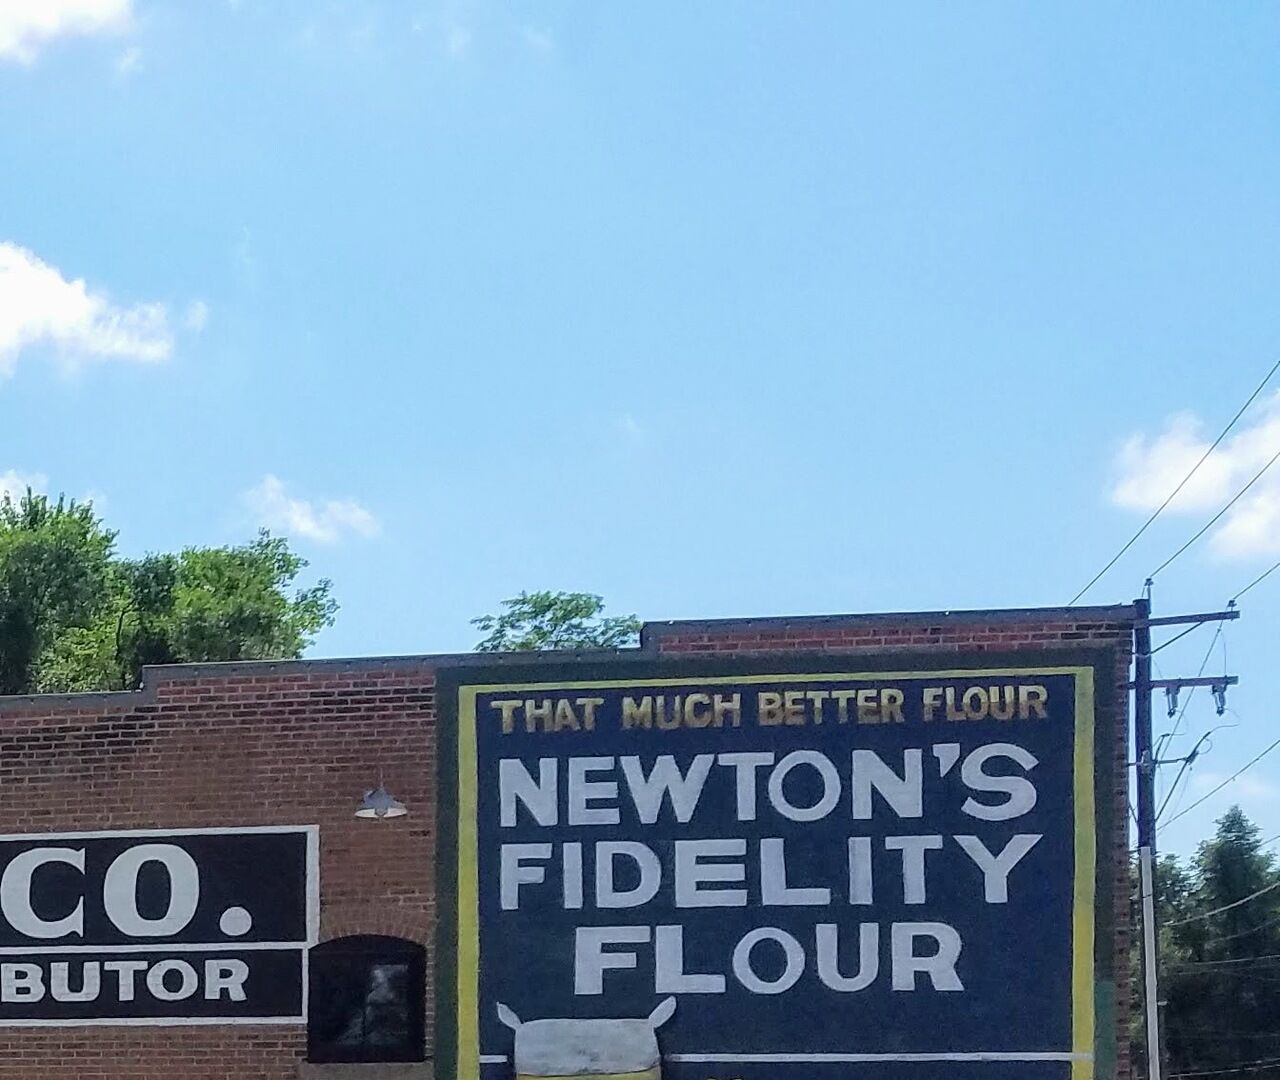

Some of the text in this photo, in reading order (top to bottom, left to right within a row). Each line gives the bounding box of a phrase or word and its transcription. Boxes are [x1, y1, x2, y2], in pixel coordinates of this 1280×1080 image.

[491, 683, 1049, 735] THAT MUCH BETTER FLOUR
[498, 742, 1040, 828] NEWTON'S
[0, 843, 253, 939] CO.
[499, 833, 1043, 910] FIDELITY
[574, 921, 965, 995] FLOUR
